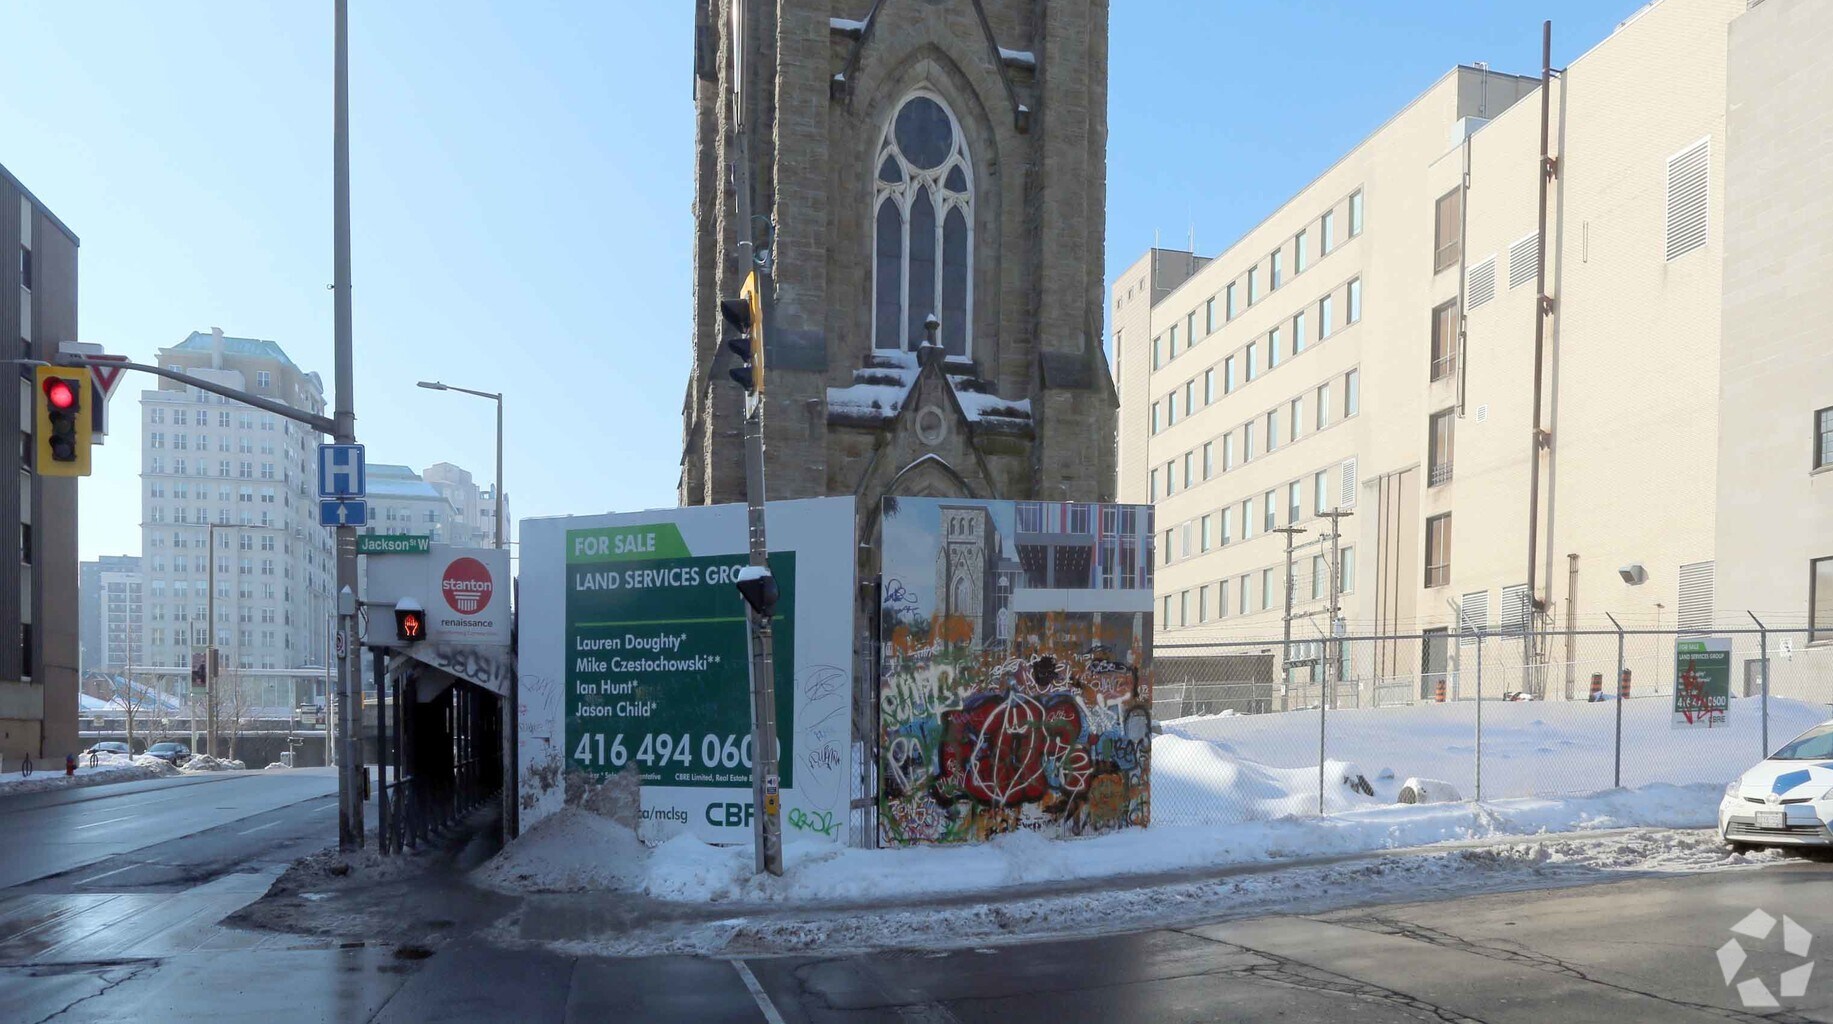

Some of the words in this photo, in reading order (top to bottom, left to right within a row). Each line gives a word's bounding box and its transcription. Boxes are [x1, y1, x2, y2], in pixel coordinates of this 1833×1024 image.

[324, 448, 358, 493] H
[362, 538, 409, 550] Jackson
[409, 538, 416, 546] St
[417, 538, 429, 550] W
[575, 535, 609, 556] FOR
[614, 532, 656, 554] SALE
[443, 578, 492, 591] stanton
[576, 572, 620, 591] LAND
[624, 567, 700, 589] SERVICES
[441, 618, 493, 627] renaissance
[576, 636, 621, 650] Lauren
[576, 657, 607, 672] Mike
[576, 680, 597, 694] Ian
[575, 702, 612, 717] Jason
[574, 733, 628, 766] 416
[636, 733, 692, 767] 494
[702, 733, 781, 768] 060
[675, 773, 690, 781] CBRE
[691, 773, 714, 782] Limited,
[715, 774, 729, 782] Real
[729, 774, 747, 782] Estate
